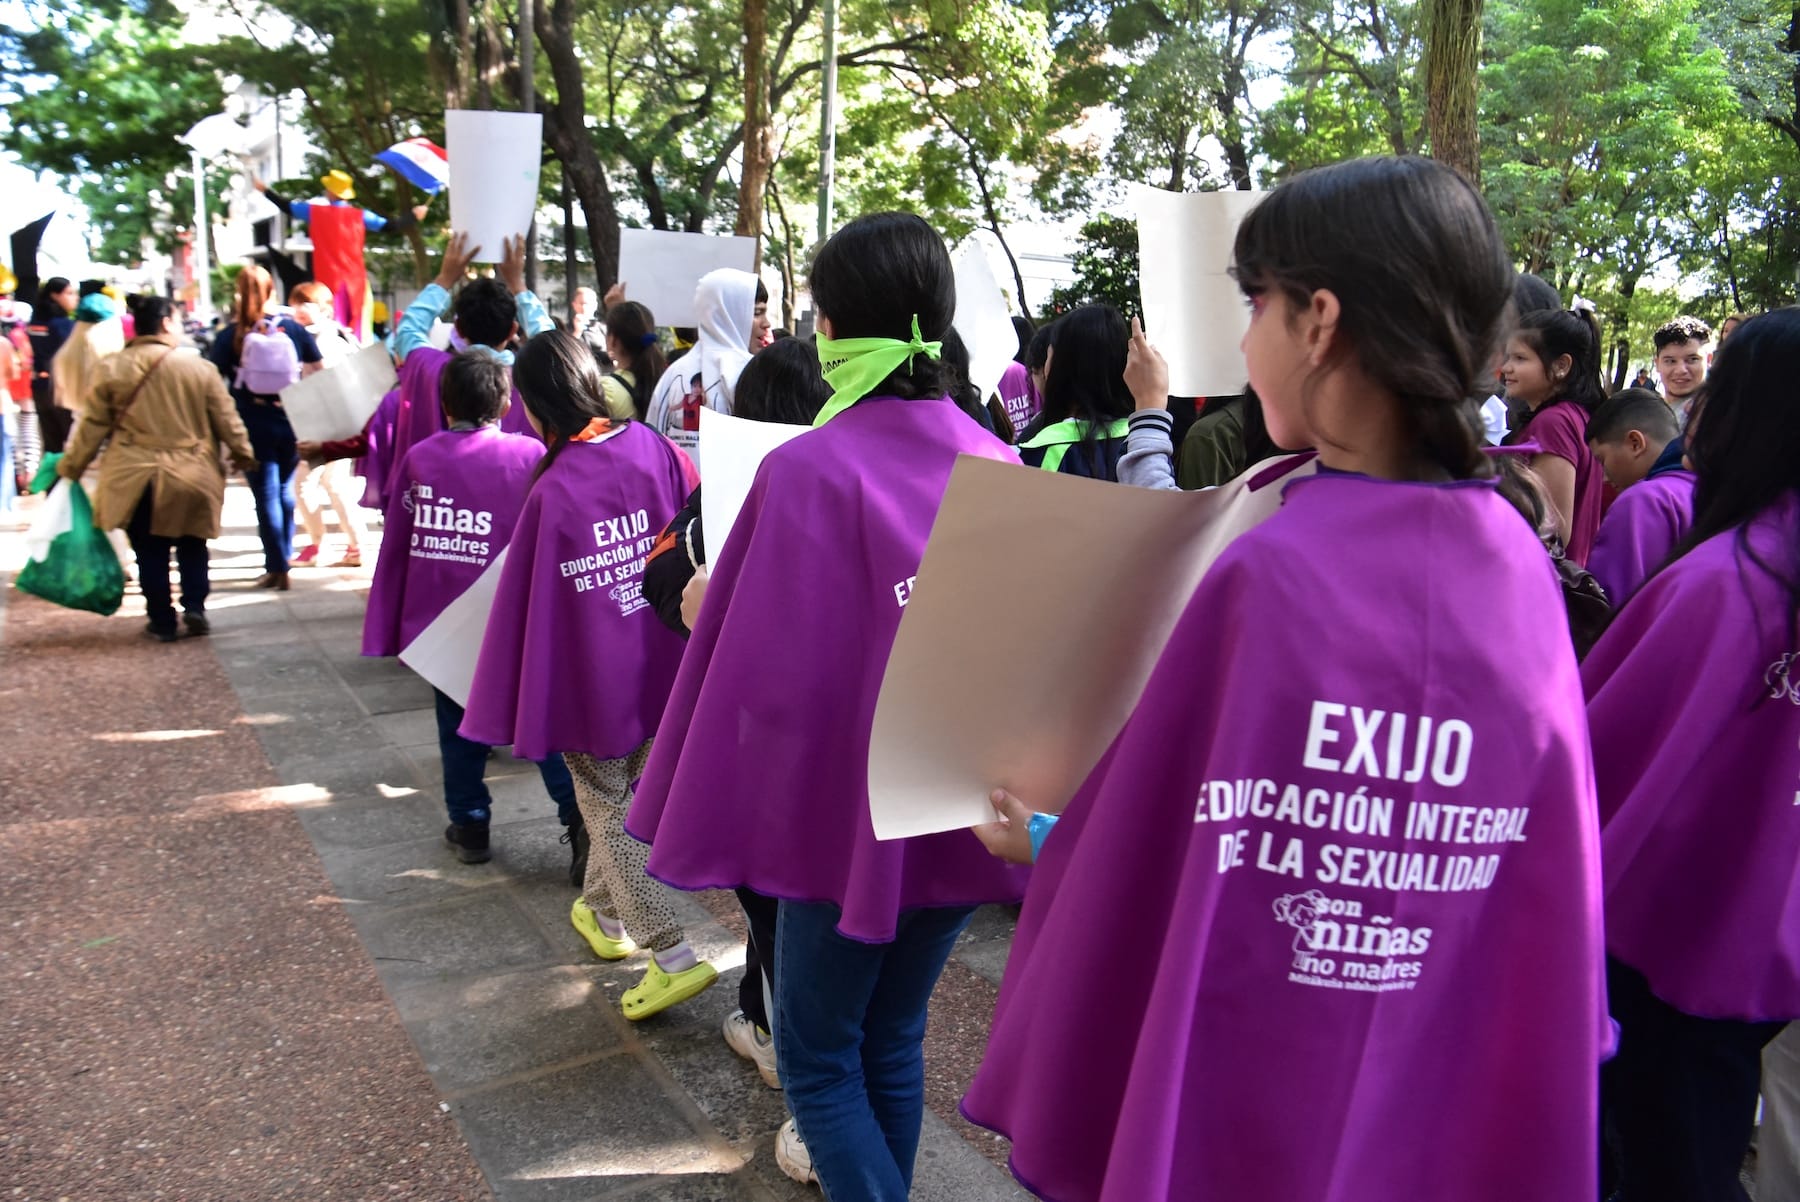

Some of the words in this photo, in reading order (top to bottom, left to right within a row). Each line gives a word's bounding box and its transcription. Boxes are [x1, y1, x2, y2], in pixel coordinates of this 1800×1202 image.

[593, 509, 649, 547] EXIJO
[423, 534, 490, 556] madres
[560, 544, 634, 577] EDUCACIÓN
[574, 575, 595, 593] DE
[595, 570, 613, 587] LA
[620, 581, 643, 603] niñ
[1303, 700, 1474, 787] EXIJO
[1194, 778, 1394, 838] EDUCACIÓN
[1405, 801, 1530, 844] INTEGRAL
[1217, 829, 1249, 874] DE
[1256, 831, 1304, 879] LA
[1316, 844, 1500, 892] SEXUALIDAD
[1315, 898, 1363, 918] son
[1308, 915, 1433, 957] niñas
[1302, 957, 1336, 975] no
[1341, 958, 1423, 981] madres
